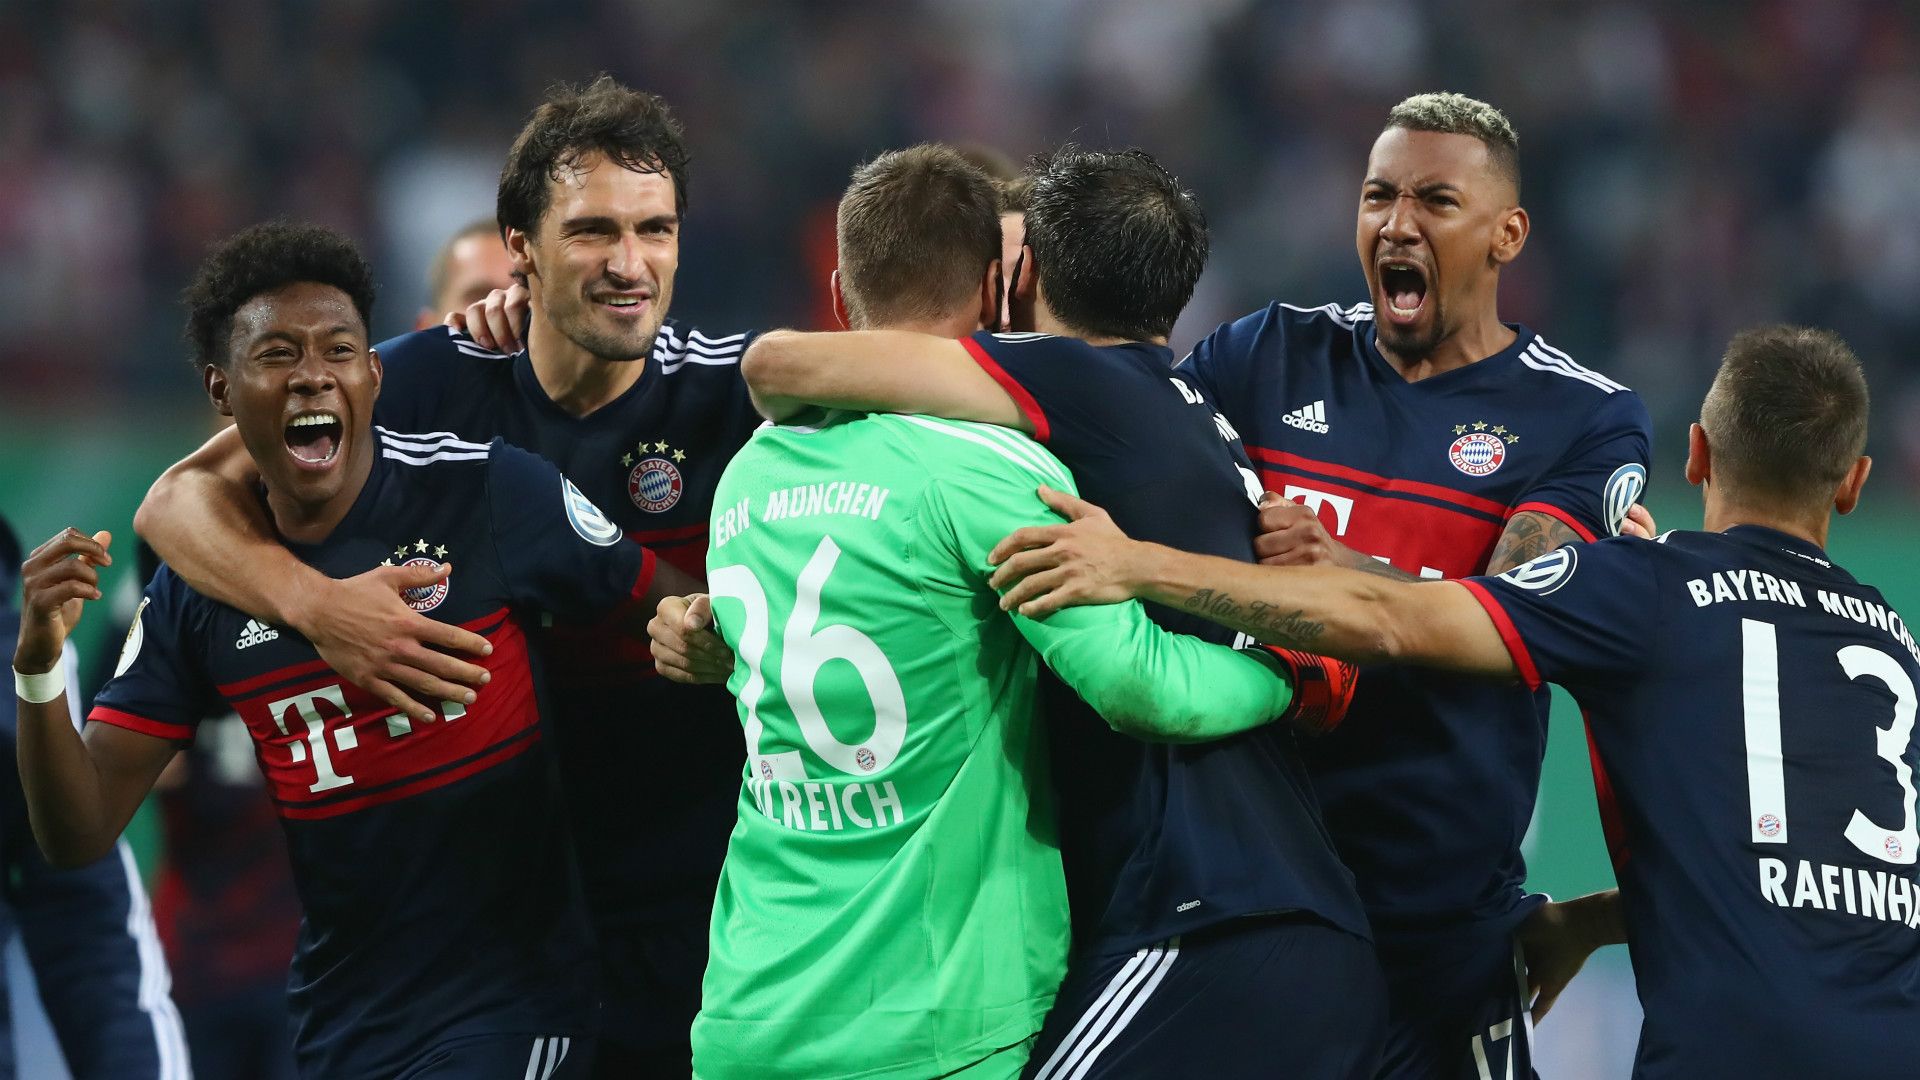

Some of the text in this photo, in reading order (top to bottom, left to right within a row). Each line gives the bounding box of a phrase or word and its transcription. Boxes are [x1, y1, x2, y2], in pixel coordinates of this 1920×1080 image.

[1282, 413, 1330, 434] adidas
[1470, 435, 1503, 455] BAYERN
[640, 461, 679, 481] BAYERN
[1686, 569, 1807, 609] BAYERN
[235, 628, 279, 650] adidas
[708, 534, 908, 779] 26
[1742, 617, 1920, 865] 13
